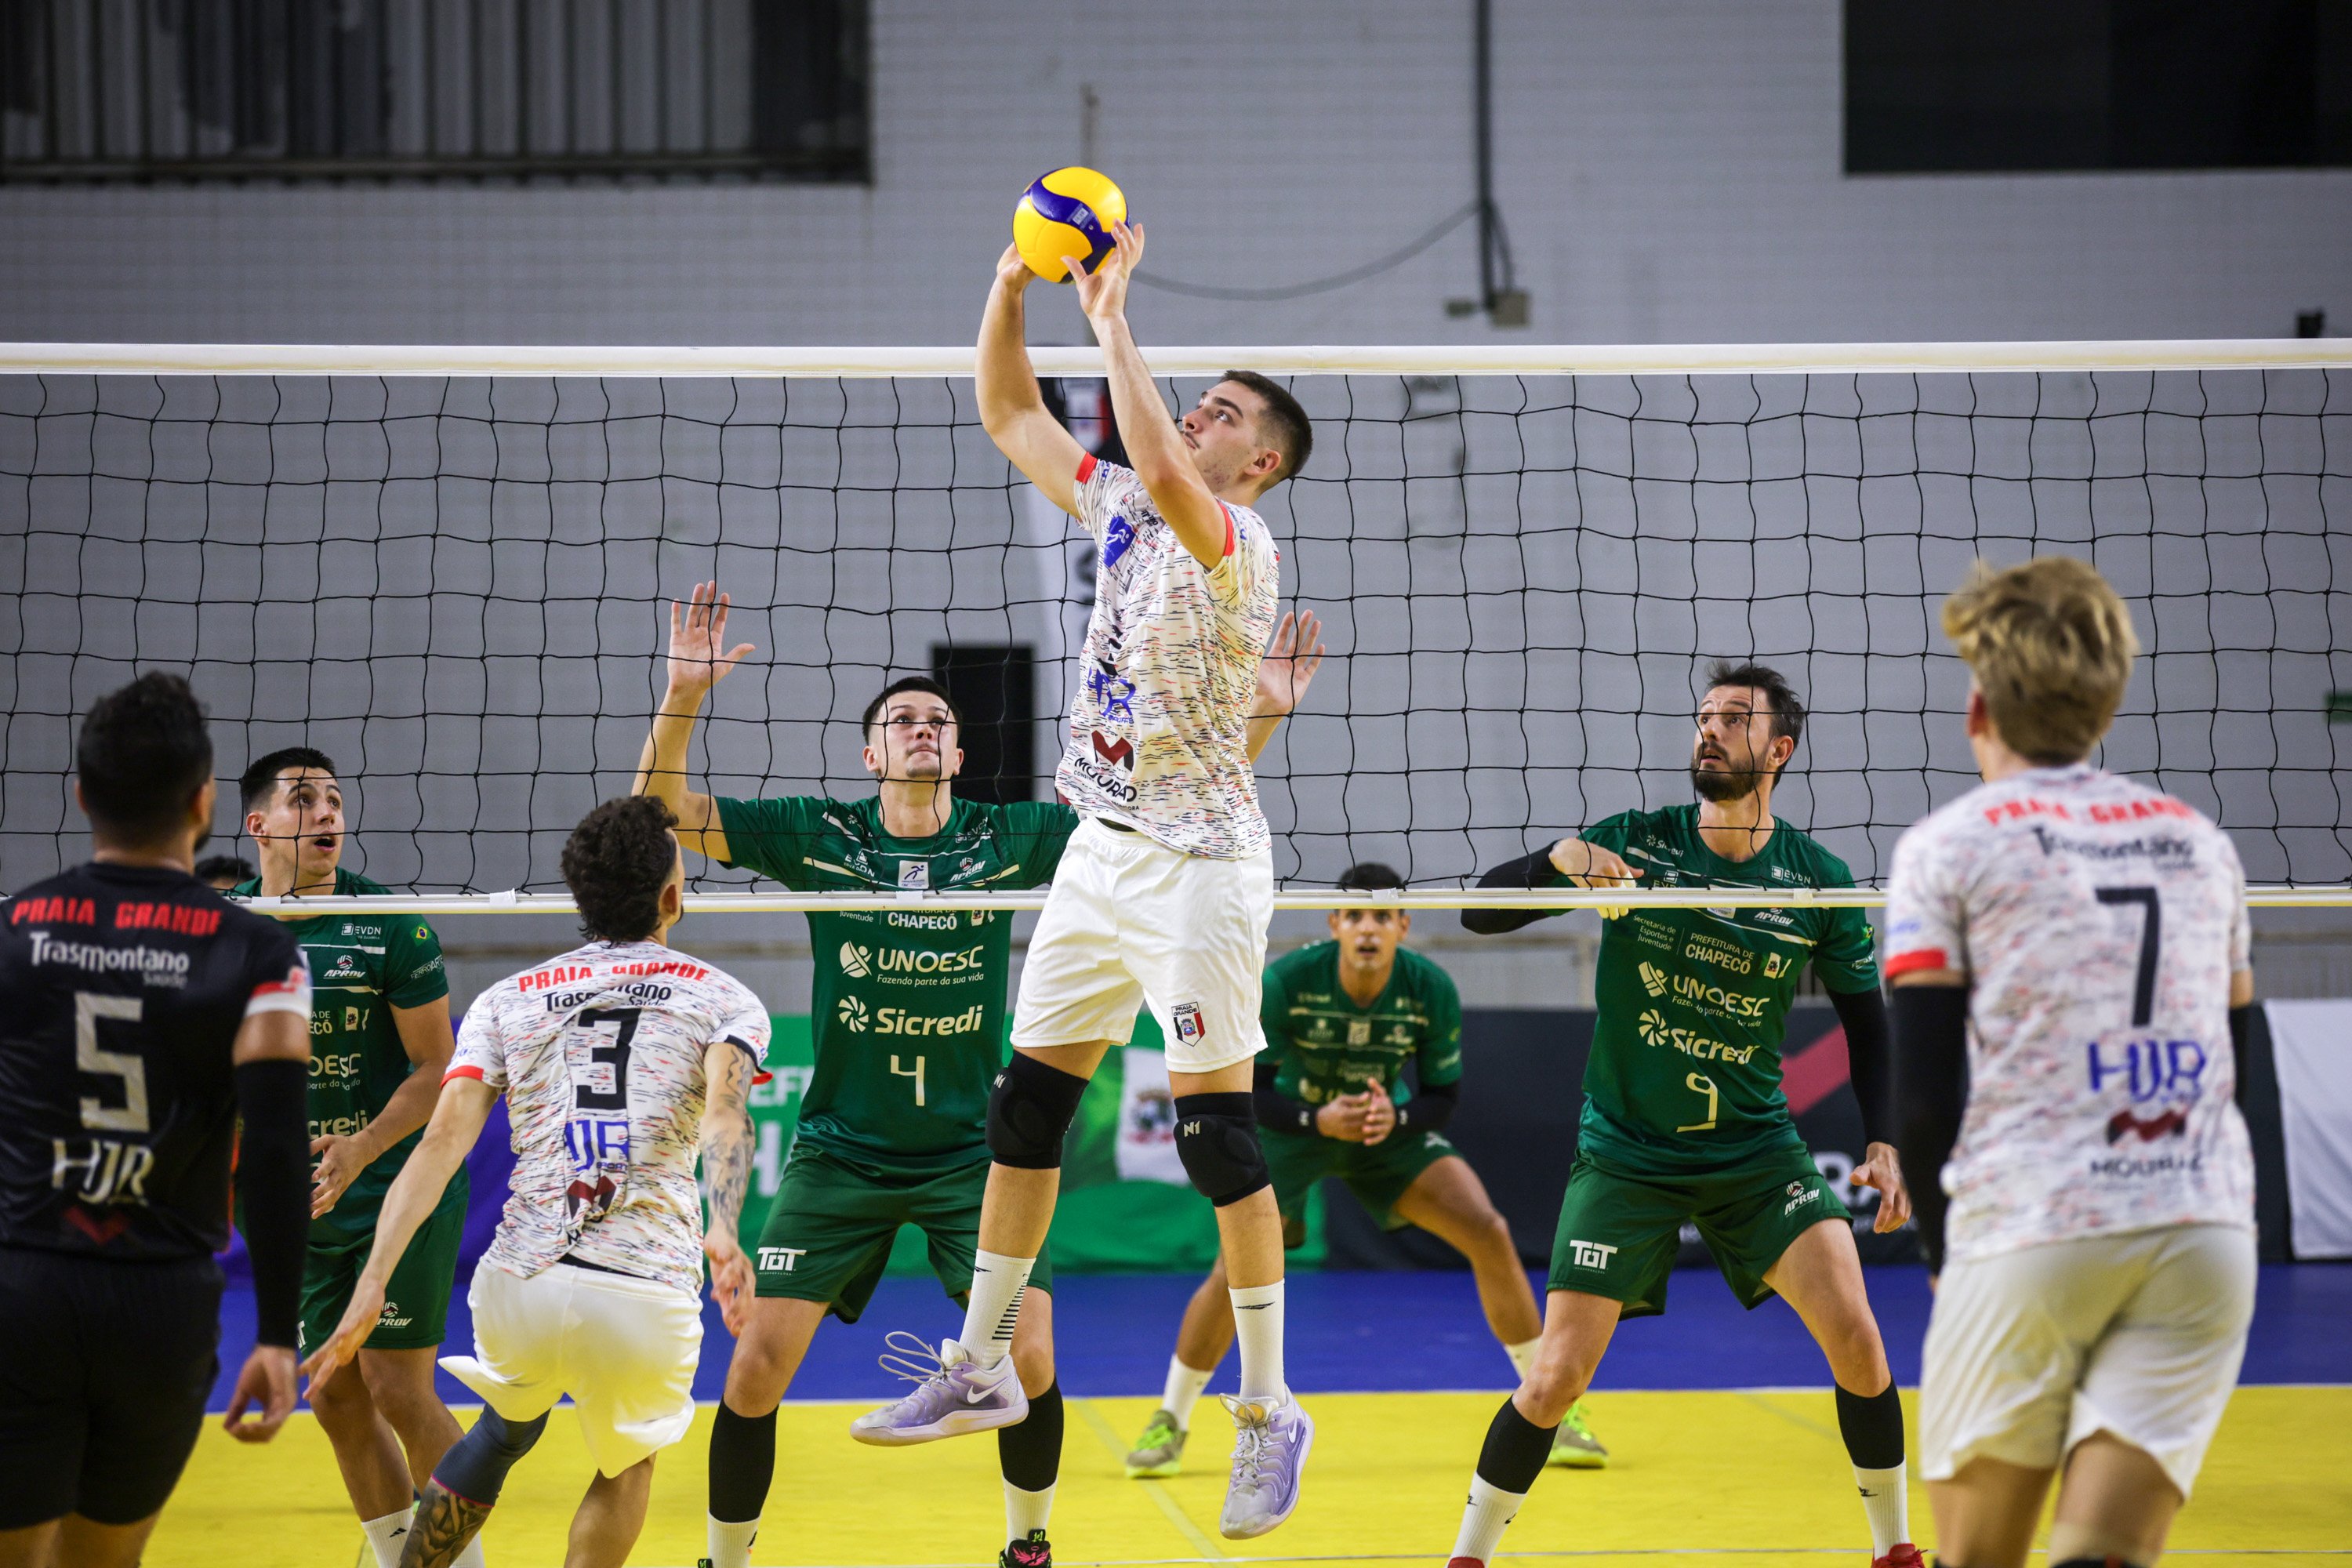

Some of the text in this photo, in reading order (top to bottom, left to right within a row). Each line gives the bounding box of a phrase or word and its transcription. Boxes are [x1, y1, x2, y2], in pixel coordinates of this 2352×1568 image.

[949, 860, 986, 881] APROV
[11, 896, 96, 926] PRAIA
[887, 912, 957, 931] CHAPECÓ
[1633, 914, 1676, 935] Secretaria de
[1754, 911, 1795, 925] APROV
[355, 926, 382, 935] EVDN
[1639, 926, 1668, 942] Esportes
[29, 931, 191, 974] Trasmontano
[877, 945, 984, 973] UNOESC
[1686, 943, 1751, 975] CHAPECÓ
[1690, 933, 1755, 960] PREFEITURA DE
[2094, 886, 2161, 1027] 7
[324, 969, 366, 978] APROV
[518, 962, 710, 992] PRAIA GRANDE
[877, 971, 985, 988] Fazendo parte da sua vida
[1673, 975, 1770, 1017] UNOESC
[318, 1011, 331, 1019] DE
[875, 1004, 984, 1036] Sicredi
[1173, 1007, 1198, 1017] GRANDE
[74, 991, 150, 1134] 5
[307, 1053, 361, 1079] OESC
[575, 1007, 642, 1110] 3
[329, 1078, 339, 1087] da
[890, 1054, 925, 1107] 4
[1676, 1072, 1719, 1133] 9
[307, 1109, 368, 1139] credi
[52, 1138, 154, 1207] HJR
[1784, 1188, 1820, 1215] APROV
[376, 1317, 413, 1327] PROV
